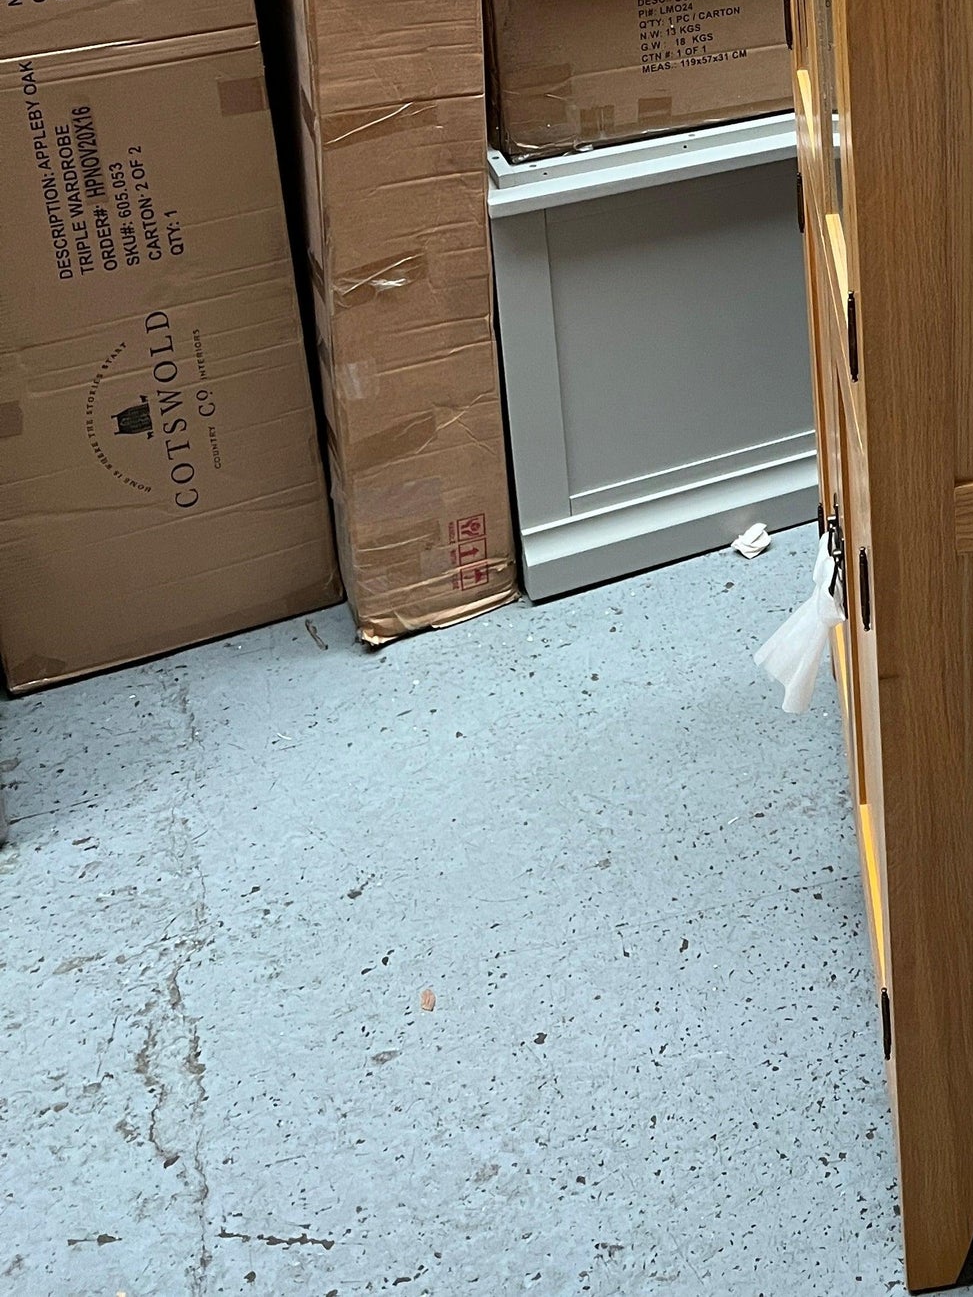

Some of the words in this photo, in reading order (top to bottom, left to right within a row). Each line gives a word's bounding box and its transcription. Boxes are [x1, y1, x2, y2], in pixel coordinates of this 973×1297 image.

[660, 2, 693, 15] LMO24
[676, 13, 690, 24] PC
[698, 6, 740, 20] CARTON
[666, 26, 676, 36] 13
[680, 23, 701, 34] KGS
[675, 37, 686, 46] 18
[692, 32, 714, 43] KGS
[641, 52, 662, 63] CTN
[684, 46, 699, 56] OF
[680, 52, 729, 68] 119x57x31
[732, 49, 747, 60] CM
[19, 60, 38, 96] OAK
[25, 100, 52, 170] APPLEBY
[72, 105, 106, 199] HPNOV20X16
[128, 145, 142, 155] 2
[55, 124, 84, 219] WARDROBE
[129, 158, 146, 180] OF
[135, 181, 149, 192] 2
[109, 162, 132, 219] 605.053
[42, 172, 73, 280] DESCRIPTION:
[164, 209, 177, 218] 1
[72, 220, 95, 276] TRIPLE
[120, 221, 140, 267] SKU#:
[166, 220, 184, 256] QTY:
[192, 328, 208, 380] INTERIORS
[144, 310, 199, 508] COTSWOLD
[208, 425, 222, 470] COUNTRY
